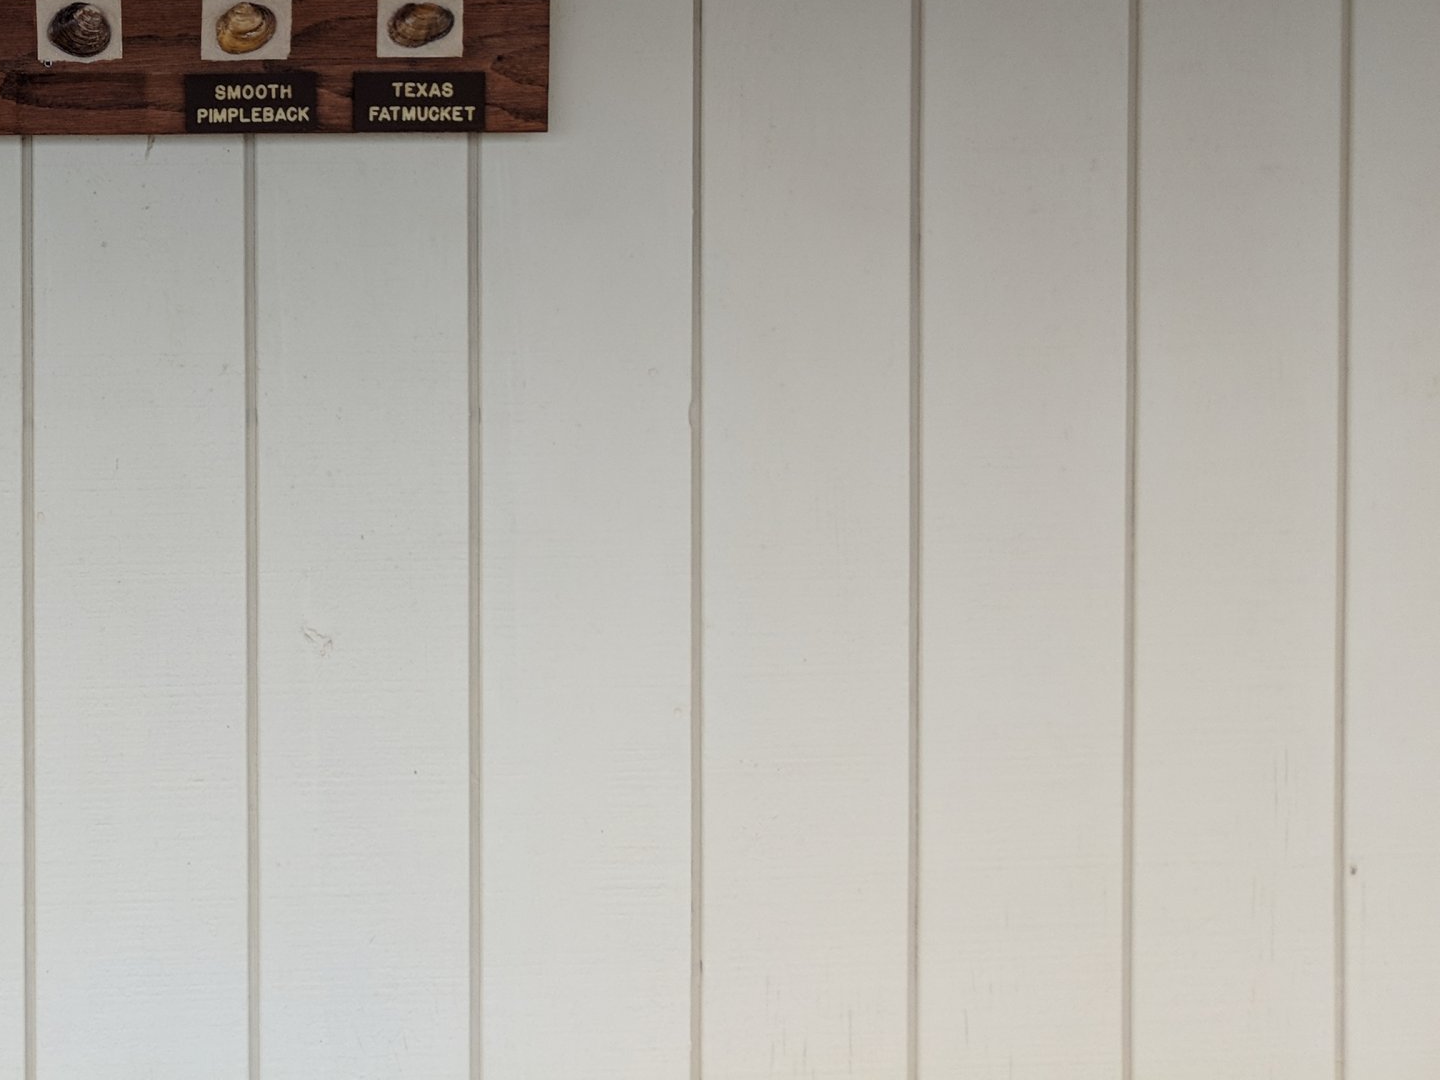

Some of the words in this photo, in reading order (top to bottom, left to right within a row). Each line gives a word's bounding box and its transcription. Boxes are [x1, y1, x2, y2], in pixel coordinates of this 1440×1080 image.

[214, 83, 293, 101] SMOOTH
[391, 82, 454, 98] TEXAS
[197, 106, 310, 124] PIMPLEBACK
[369, 105, 476, 122] FATMUCKET
